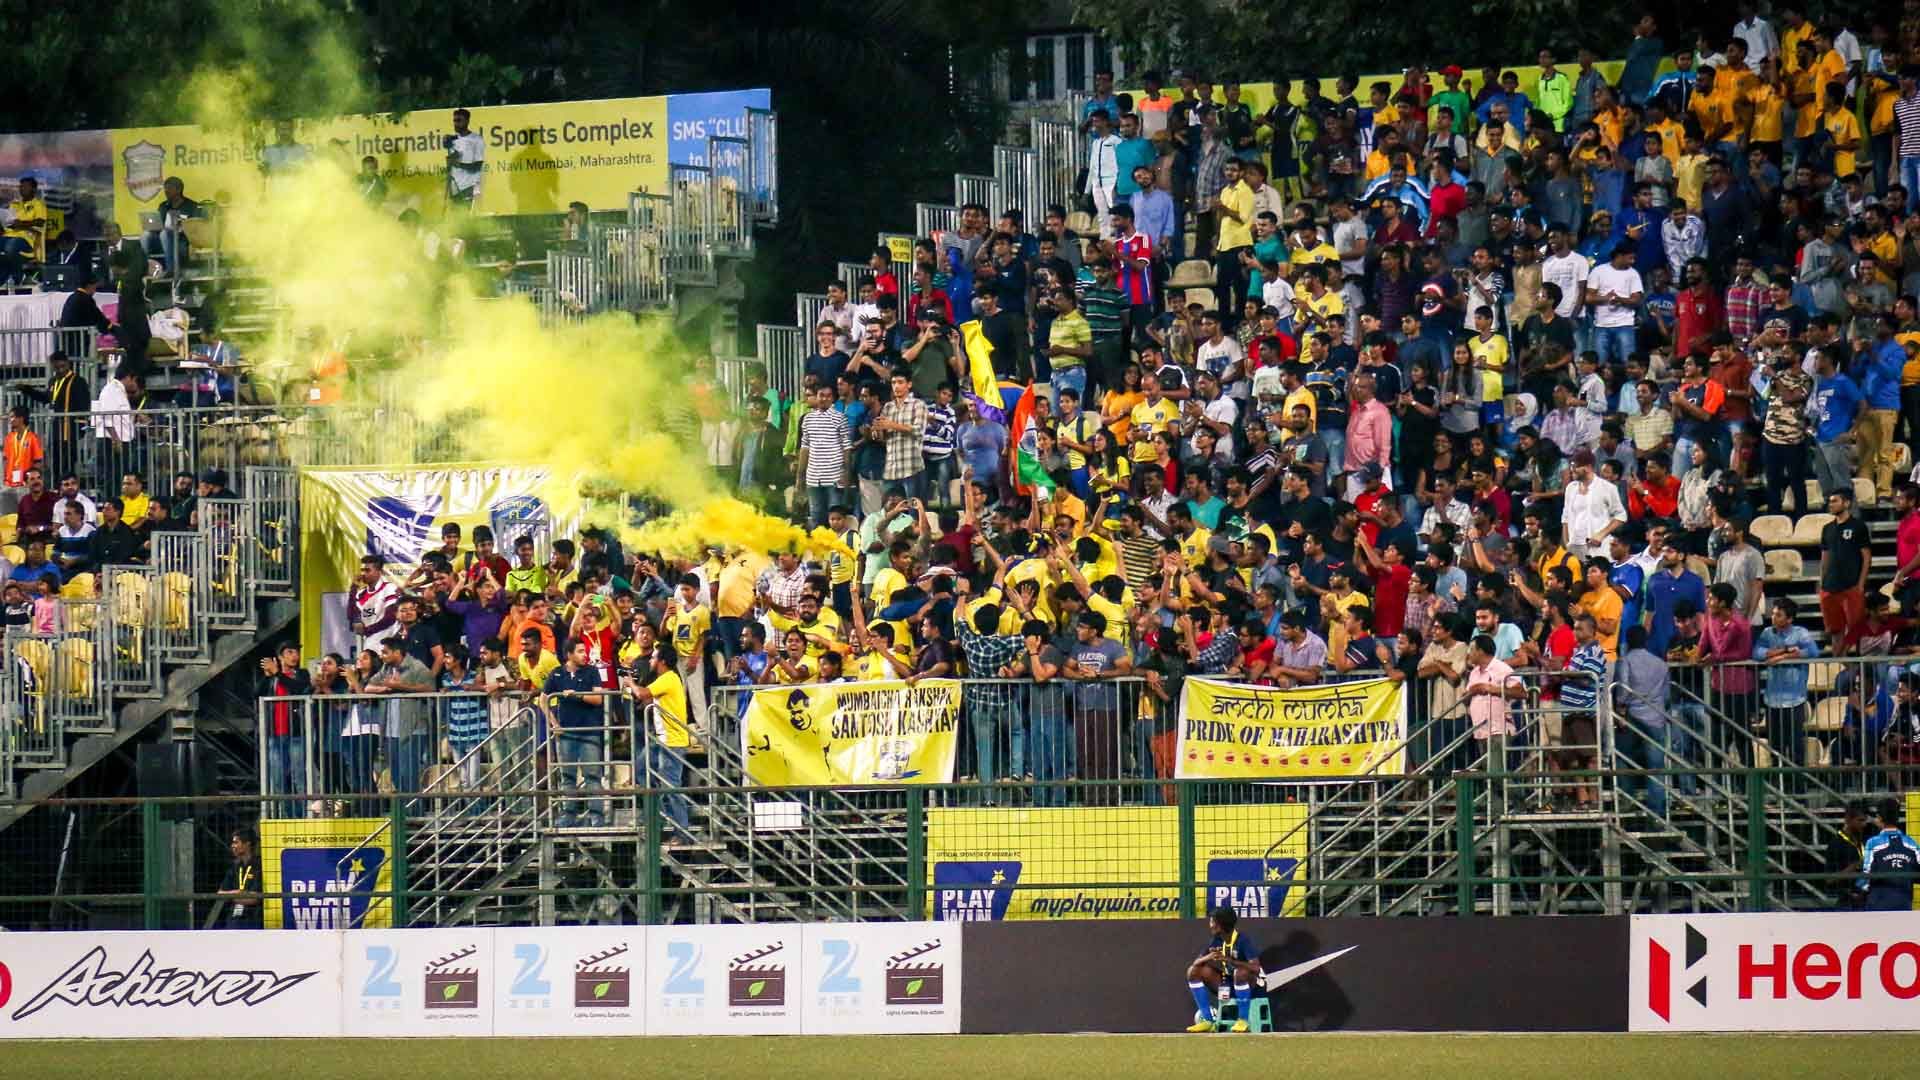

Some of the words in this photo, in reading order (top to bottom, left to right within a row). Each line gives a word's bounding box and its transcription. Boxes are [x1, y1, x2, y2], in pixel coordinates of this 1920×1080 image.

[490, 124, 558, 151] Sports
[562, 117, 655, 145] Complex
[672, 120, 706, 140] SMS
[525, 158, 577, 171] Mumbai,
[580, 151, 656, 167] Maharashtra.
[1185, 719, 1235, 743] PRIDE
[1240, 726, 1264, 745] OF
[1268, 720, 1400, 746] MAHARASHTRA
[942, 887, 996, 908] PLAY
[1215, 886, 1271, 907] PLAY
[292, 907, 351, 929] WIN
[12, 945, 320, 1021] Achiever
